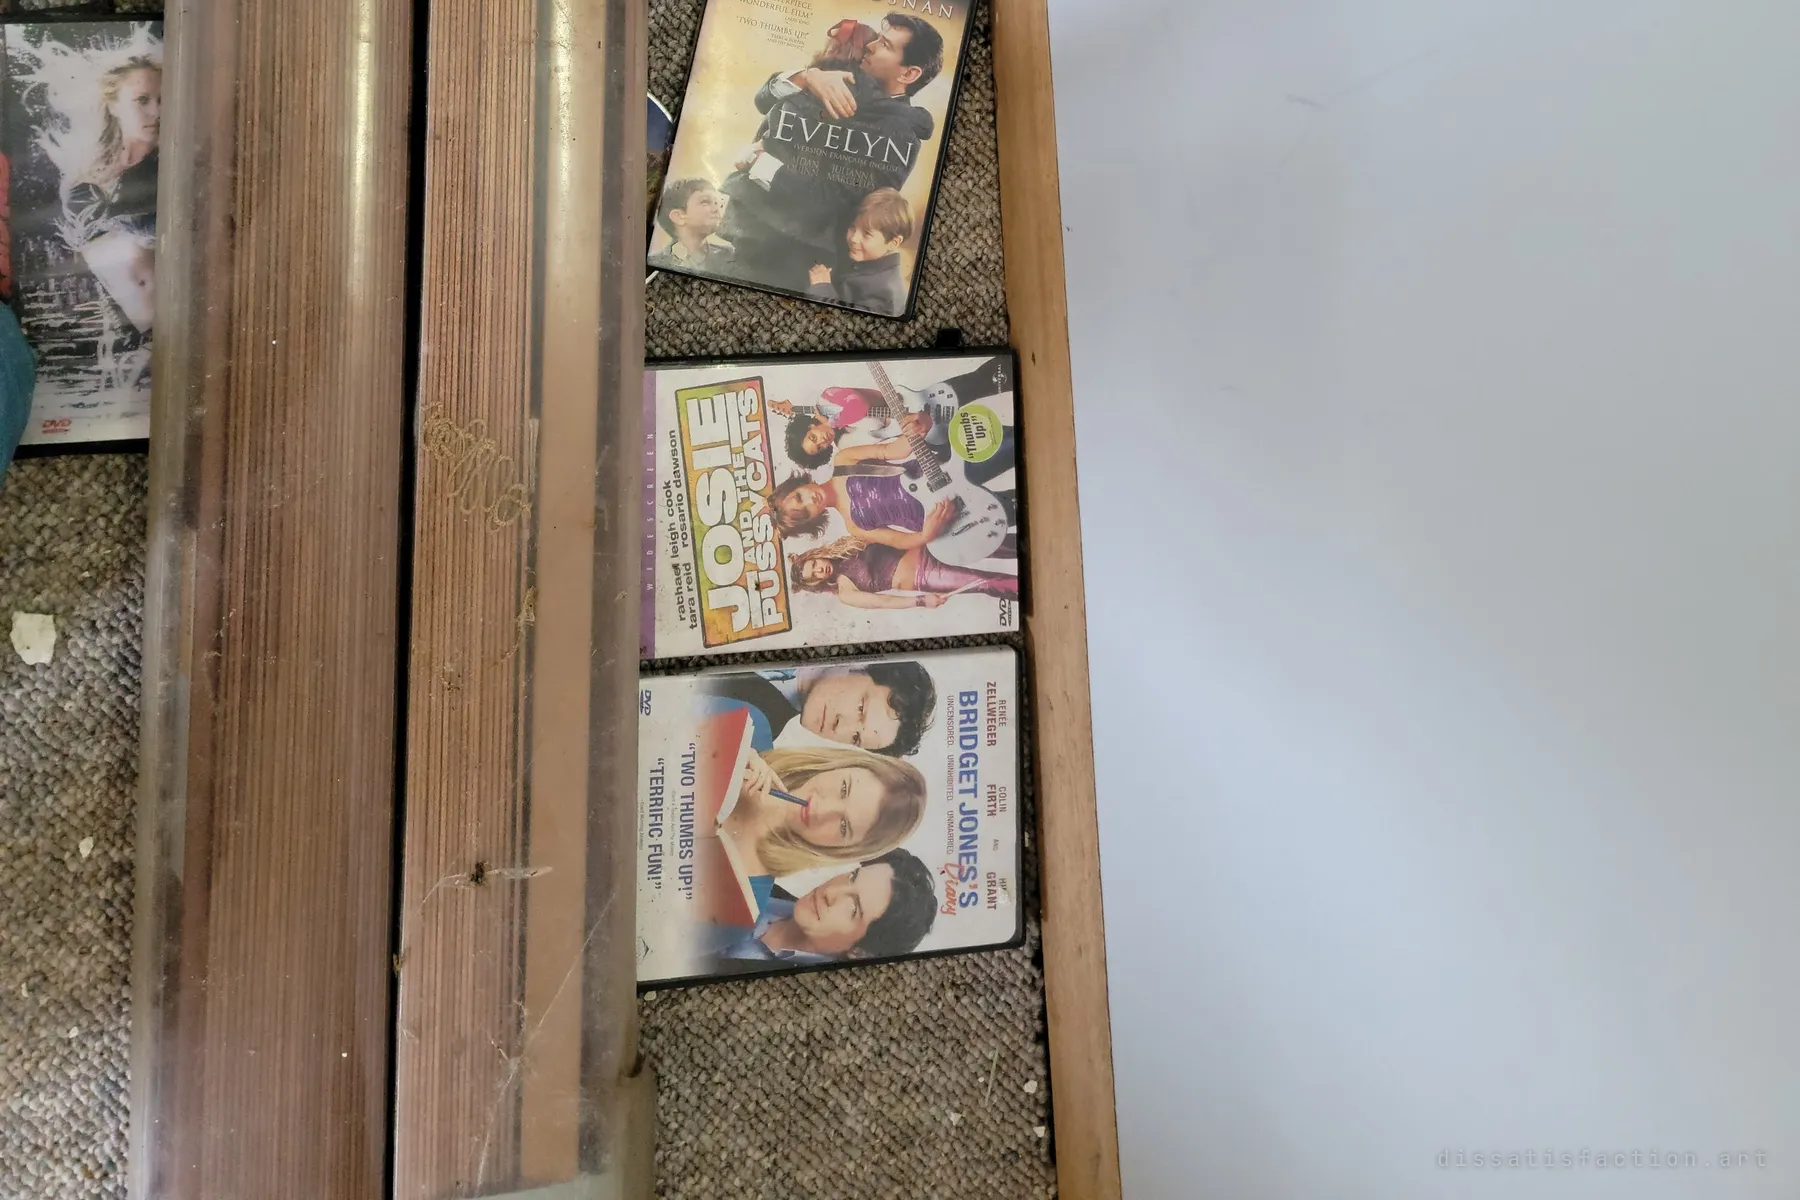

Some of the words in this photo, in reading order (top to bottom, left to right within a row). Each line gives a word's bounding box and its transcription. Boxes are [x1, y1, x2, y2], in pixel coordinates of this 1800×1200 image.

[760, 21, 792, 36] THUMBS
[773, 109, 914, 167] EVELYN
[792, 156, 820, 168] AIDAN
[786, 164, 820, 177] QUINN
[42, 419, 72, 429] DVD
[668, 430, 682, 488] dawson
[732, 452, 749, 503] THE
[663, 480, 675, 517] cook
[675, 494, 688, 548] rosario
[686, 392, 751, 632] JOSIE
[738, 388, 784, 626] PUSSYCATS
[668, 522, 679, 558] leigh
[740, 510, 757, 563] AND
[671, 563, 686, 622] rachael
[682, 562, 693, 592] reid
[687, 597, 698, 630] tara
[999, 598, 1007, 627] DVD
[946, 695, 954, 748] UNCENSORED.
[987, 682, 996, 746] ZELLWEGER
[959, 691, 978, 798] BRIDGET
[648, 758, 664, 838] “TERRIFIC
[987, 784, 996, 817] FIRTH
[679, 792, 694, 860] THUMBS
[940, 863, 965, 915] Diary
[986, 872, 996, 910] GRANT
